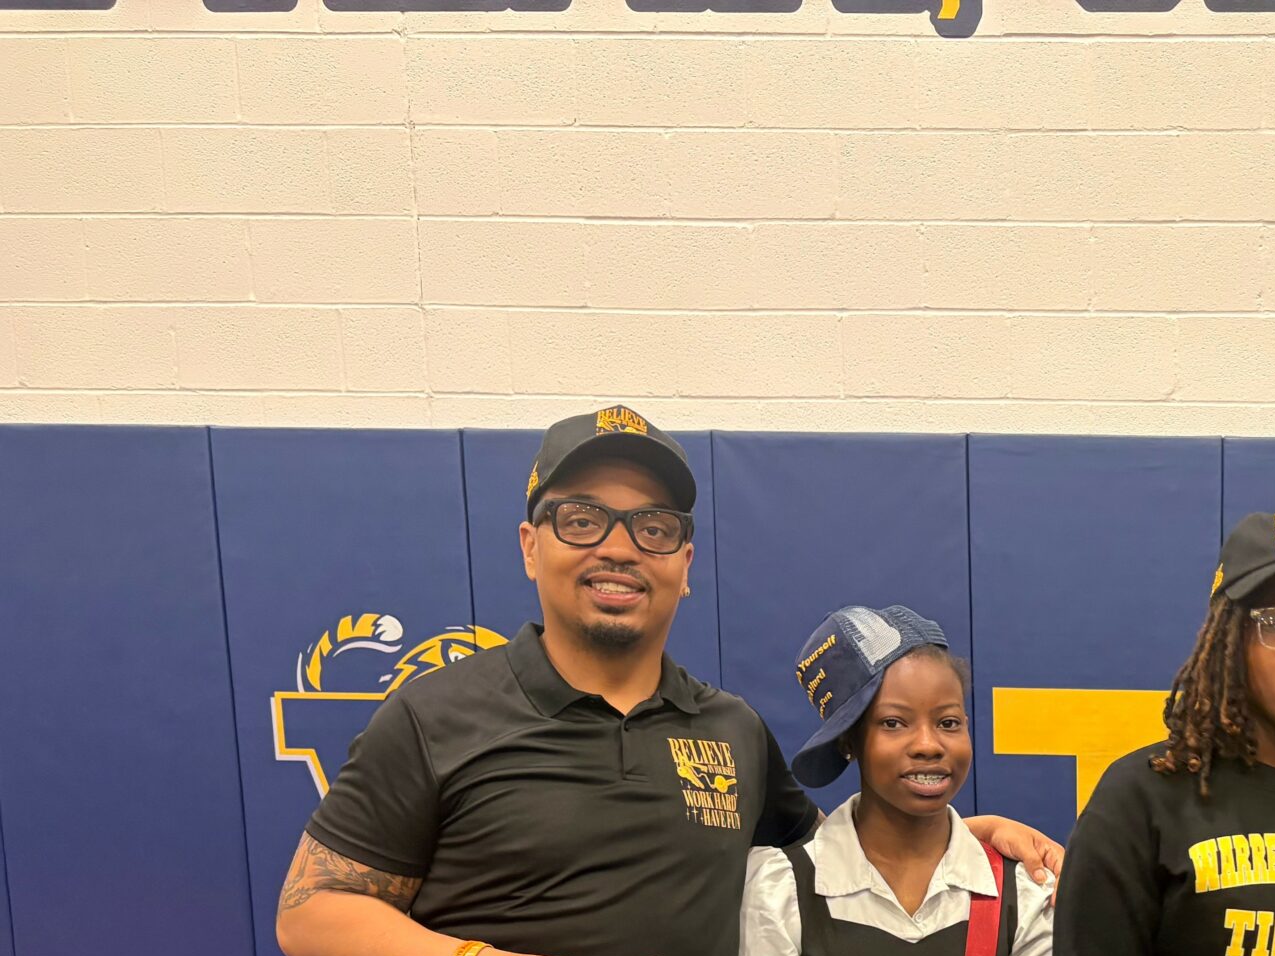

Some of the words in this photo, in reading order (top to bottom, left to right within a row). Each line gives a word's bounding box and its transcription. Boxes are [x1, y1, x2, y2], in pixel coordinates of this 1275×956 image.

[597, 408, 647, 433] BELIEVE
[667, 738, 735, 767] BELIEVE
[682, 790, 714, 809] WORK
[714, 792, 737, 811] HARD
[703, 808, 727, 828] HAVE
[727, 811, 741, 830] FUN
